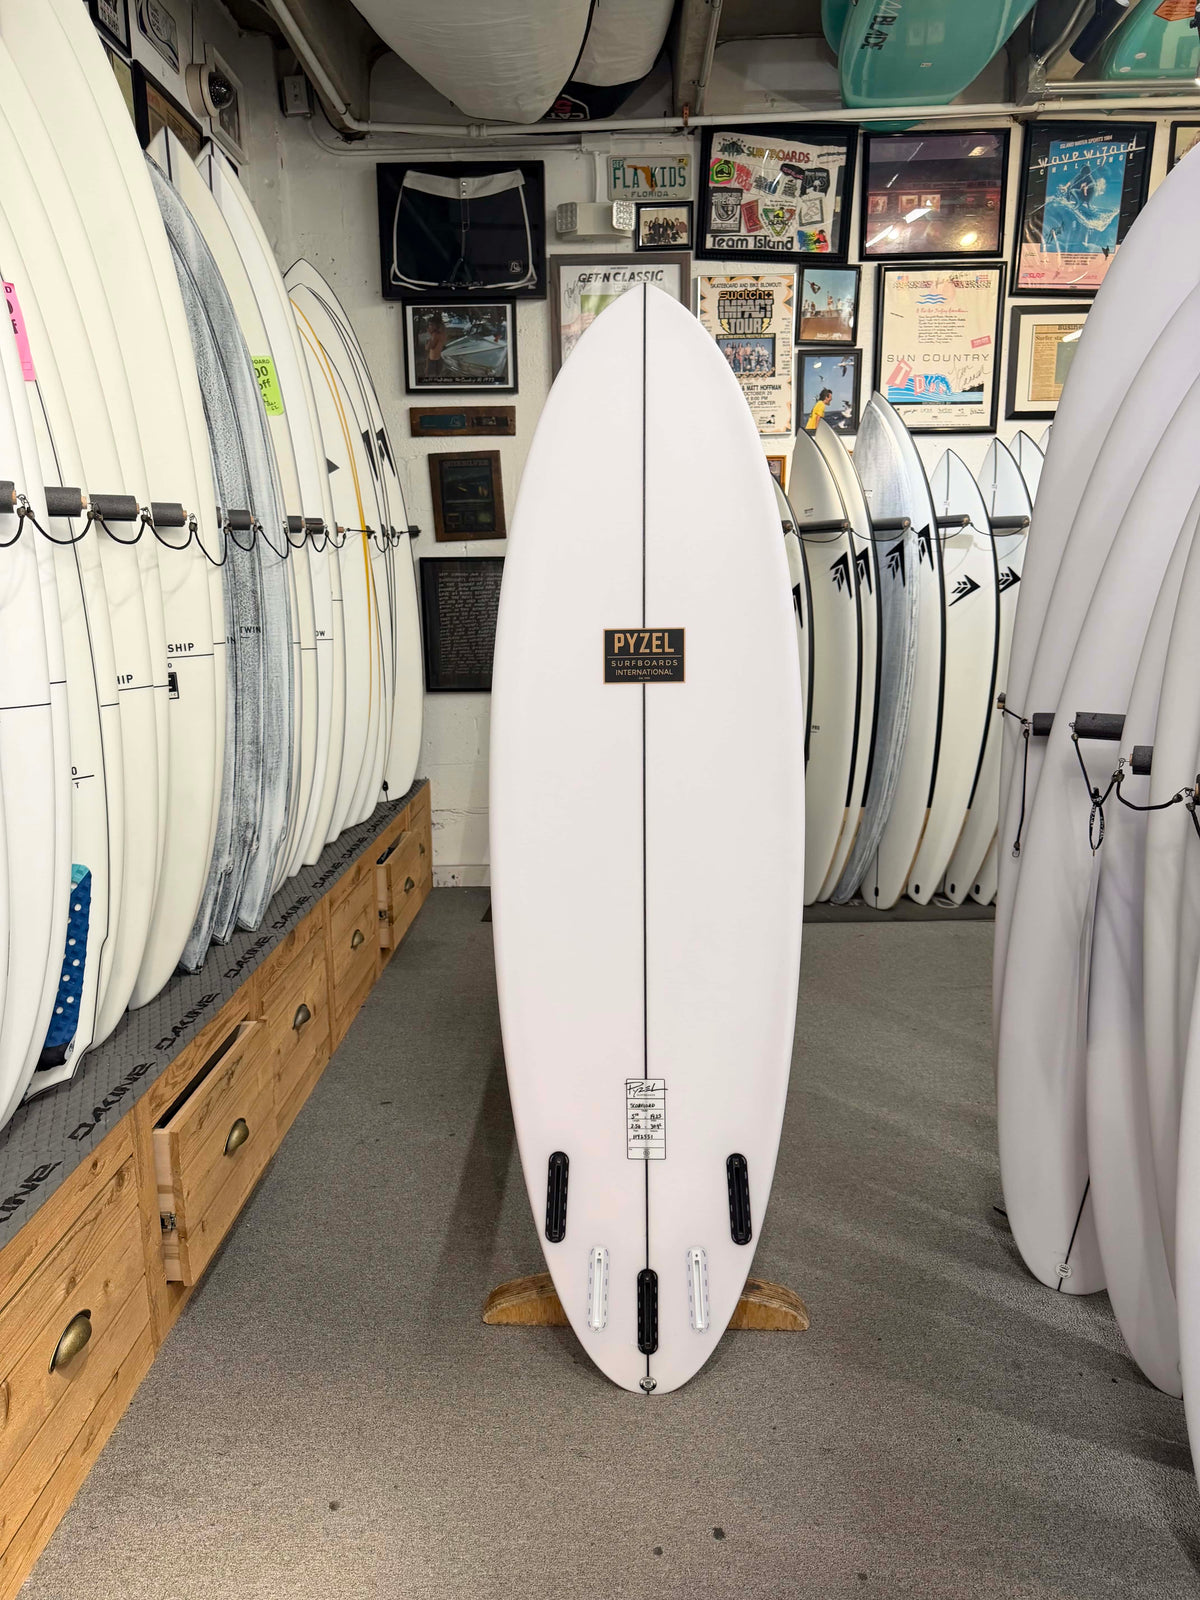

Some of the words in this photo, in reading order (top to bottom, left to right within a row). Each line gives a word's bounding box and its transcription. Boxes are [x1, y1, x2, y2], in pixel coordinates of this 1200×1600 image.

[746, 146, 811, 164] SURFBOARDS
[1039, 153, 1134, 175] CHALLENGE
[613, 167, 640, 189] FLA
[651, 166, 686, 188] KIDS
[711, 235, 749, 249] Team
[753, 236, 794, 251] Island
[613, 270, 664, 282] CLASSIC
[719, 288, 764, 300] swatch
[718, 299, 774, 318] IMPACT
[728, 318, 763, 334] TOUR
[886, 354, 916, 363] SUN
[922, 353, 990, 362] COUNTRY
[614, 632, 674, 653] PYZEL
[611, 659, 678, 667] SURFBOARDS
[615, 668, 673, 676] INTERNATIONAL
